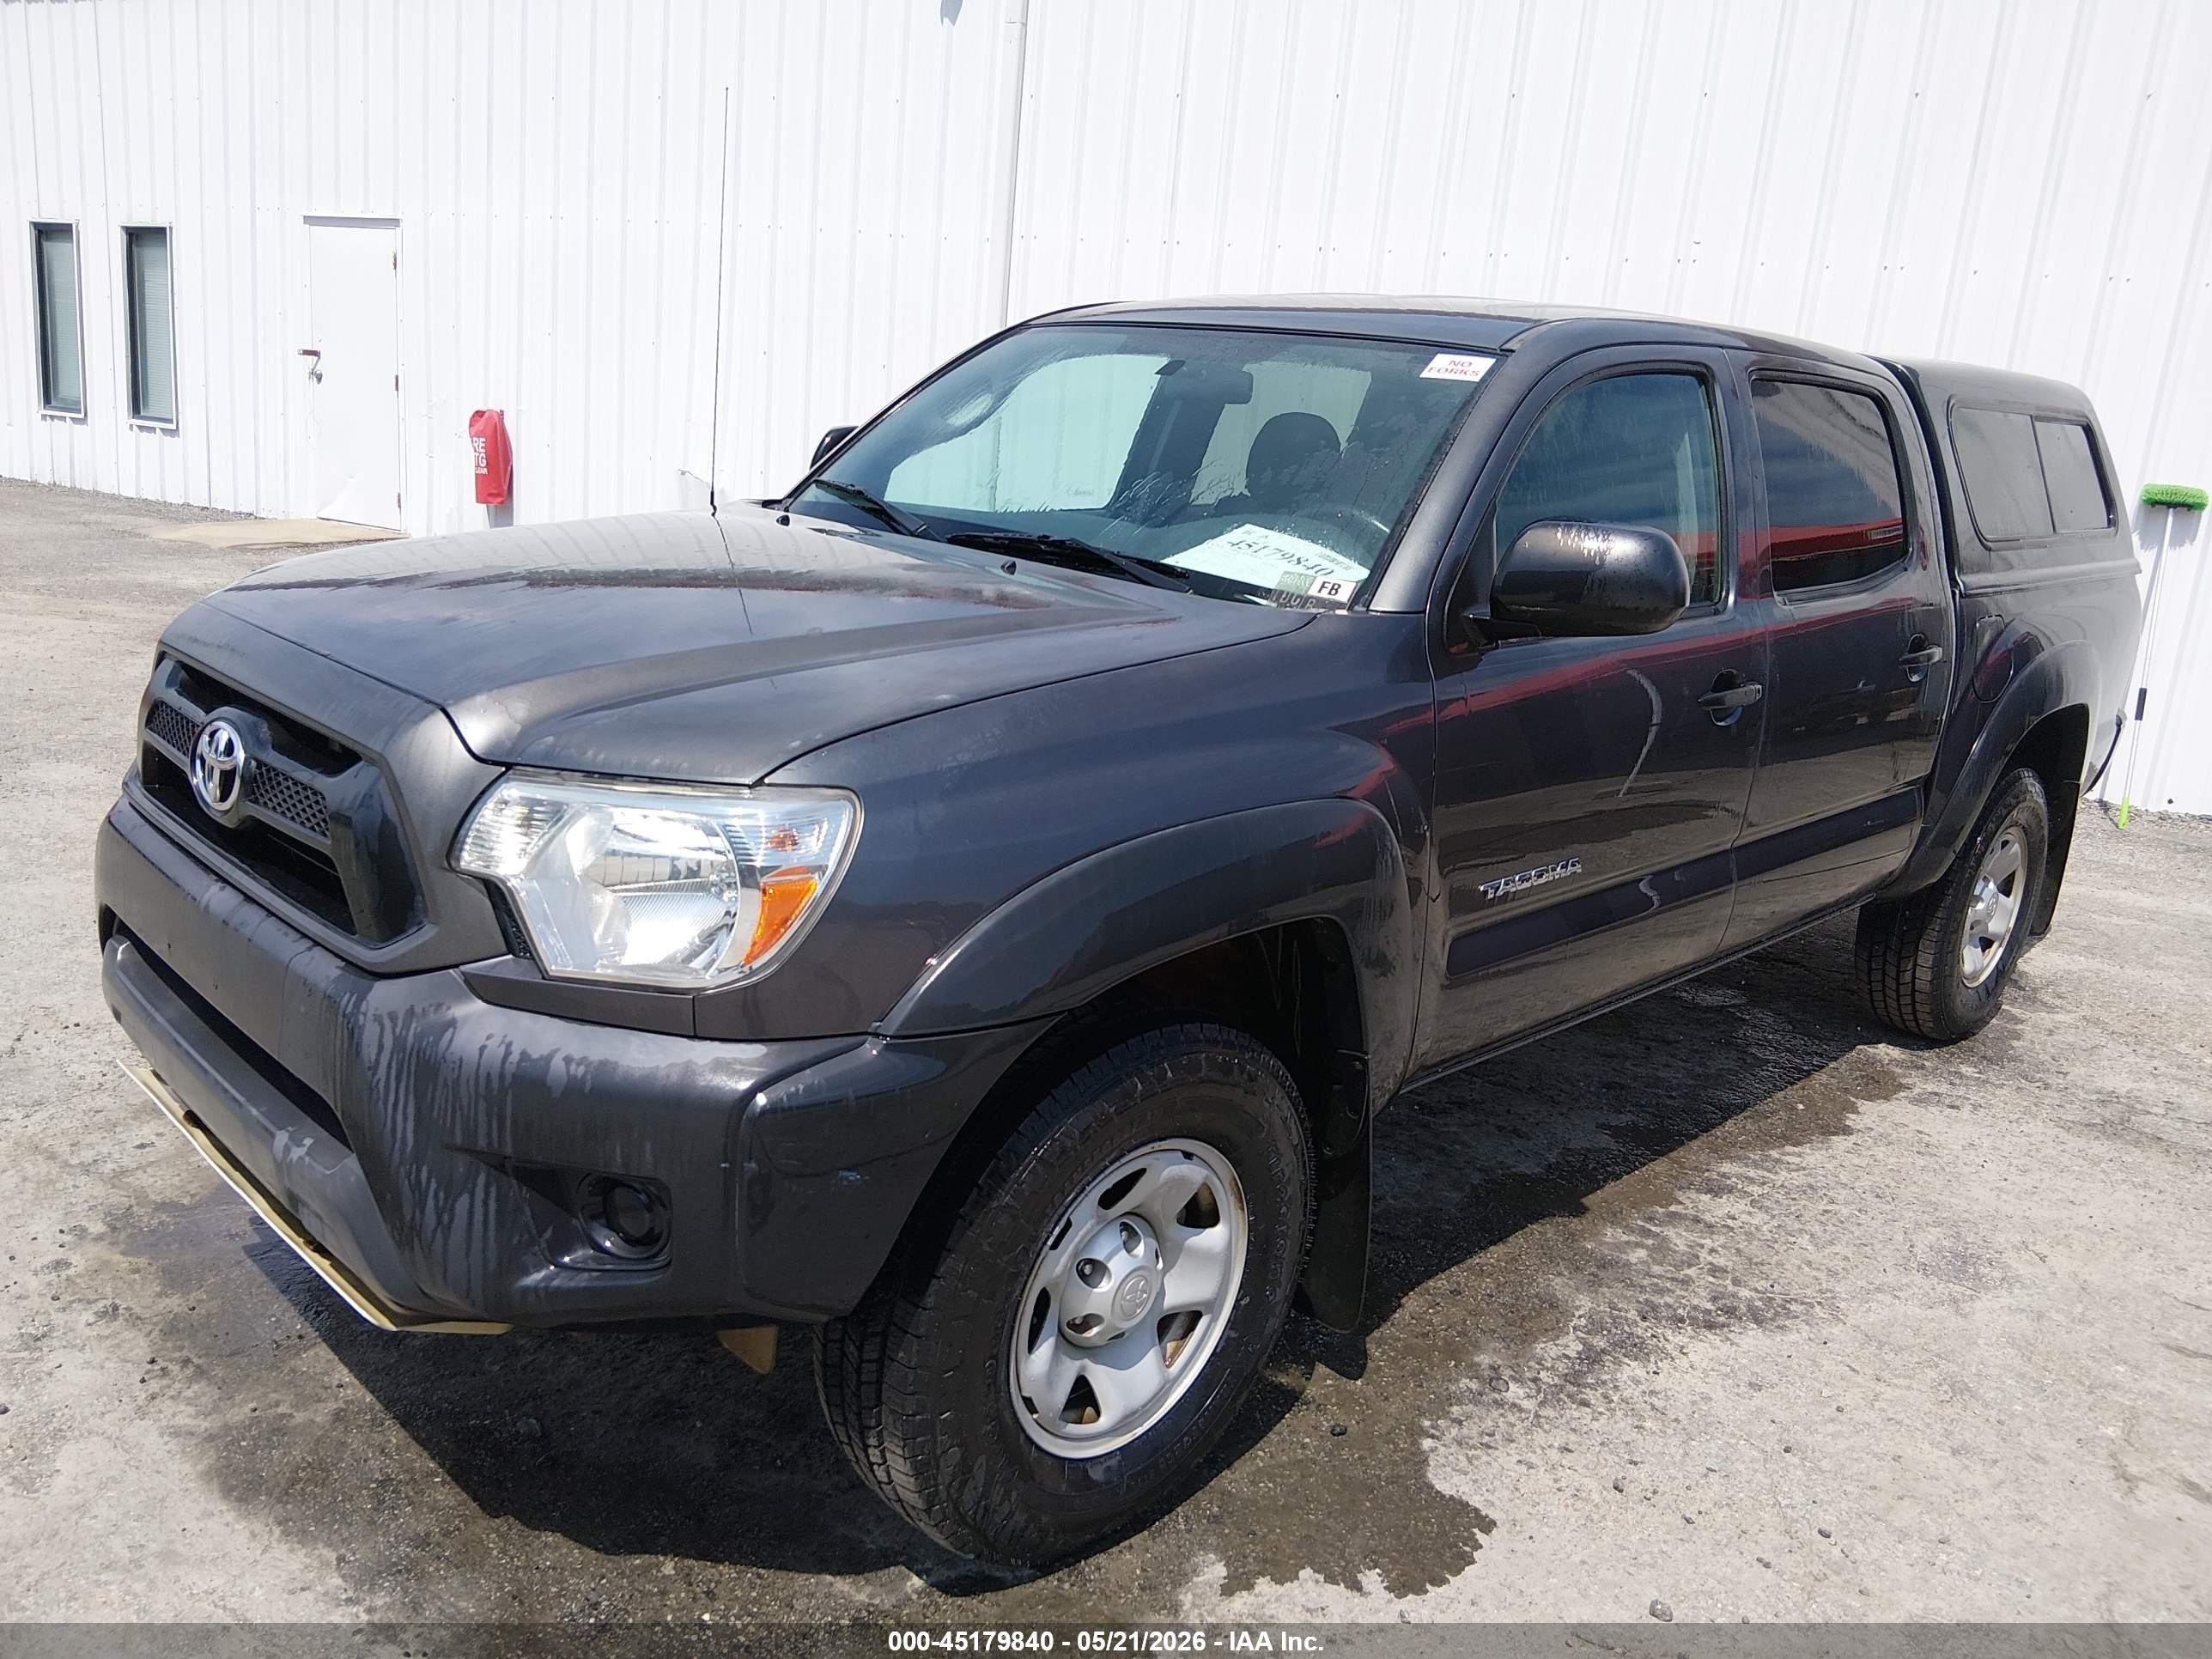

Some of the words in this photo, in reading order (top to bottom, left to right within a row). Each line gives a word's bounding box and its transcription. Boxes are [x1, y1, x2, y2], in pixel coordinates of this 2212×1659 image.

[1427, 367, 1480, 376] FORKS
[471, 436, 486, 453] RE
[474, 452, 487, 467] TG
[1226, 538, 1334, 576] 45179840
[1317, 580, 1342, 596] FB
[1478, 858, 1582, 900] TACOMA
